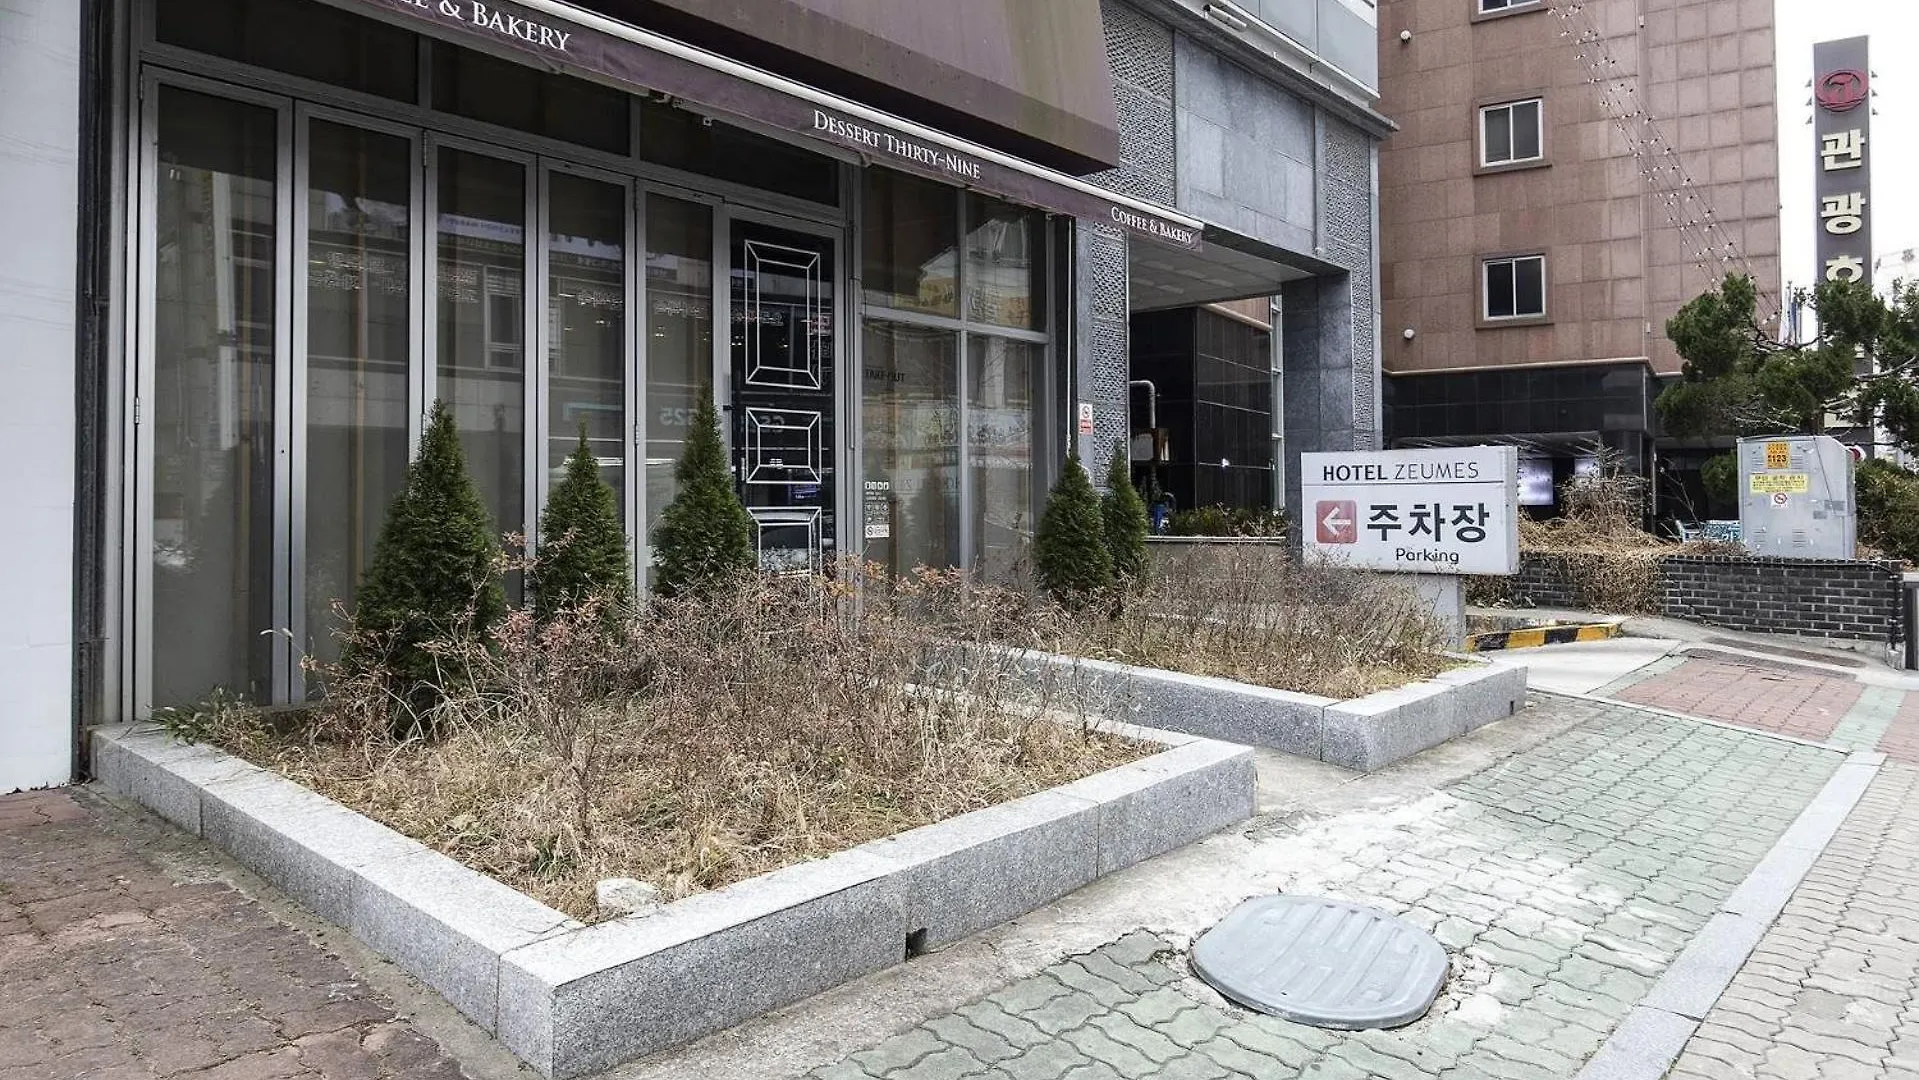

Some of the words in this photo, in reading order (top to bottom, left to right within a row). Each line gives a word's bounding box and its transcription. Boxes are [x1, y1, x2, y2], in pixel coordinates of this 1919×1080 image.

[471, 0, 572, 51] BAKERY
[813, 109, 881, 147] DESSERT
[883, 133, 982, 180] THIRTY-NINE
[1111, 206, 1148, 231] COFFEE
[1149, 219, 1158, 234] &
[1159, 222, 1193, 244] BAKERY
[1323, 464, 1388, 482] HOTEL
[1393, 461, 1480, 480] ZEUMES
[1367, 502, 1490, 543] 주차장
[1395, 548, 1459, 565] Parking
